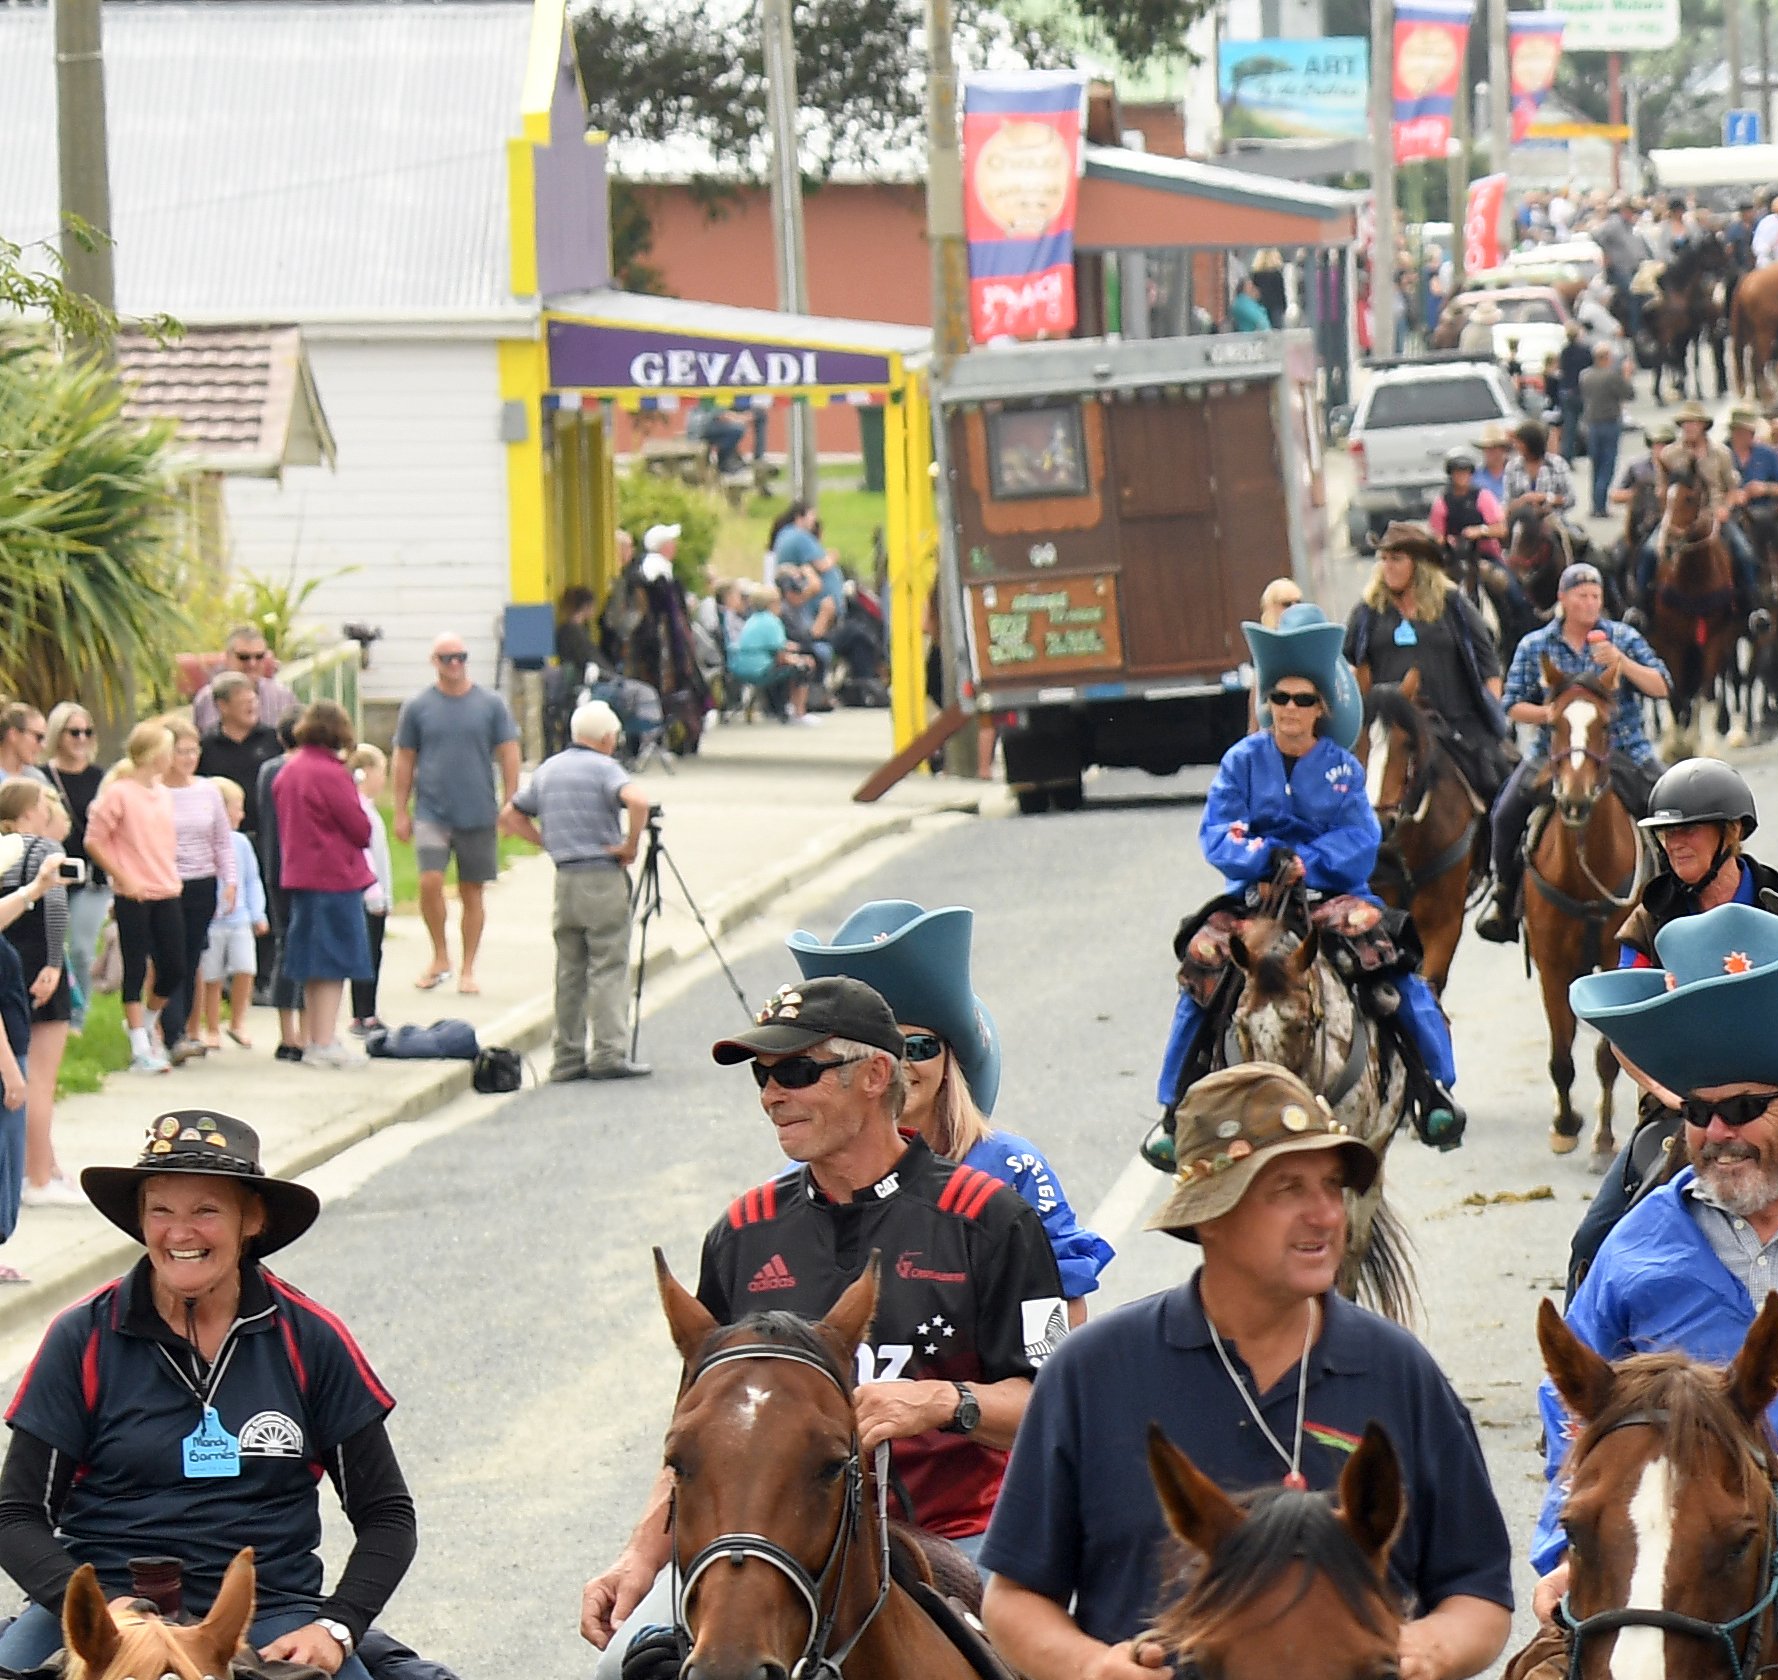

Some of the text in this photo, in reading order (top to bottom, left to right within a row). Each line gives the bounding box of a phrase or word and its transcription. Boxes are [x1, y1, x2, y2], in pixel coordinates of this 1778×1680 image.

[1305, 55, 1356, 76] ART
[629, 348, 819, 387] GEVADI
[873, 1173, 900, 1199] CAT
[747, 1274, 797, 1293] adidas
[188, 1448, 237, 1463] Barnes
